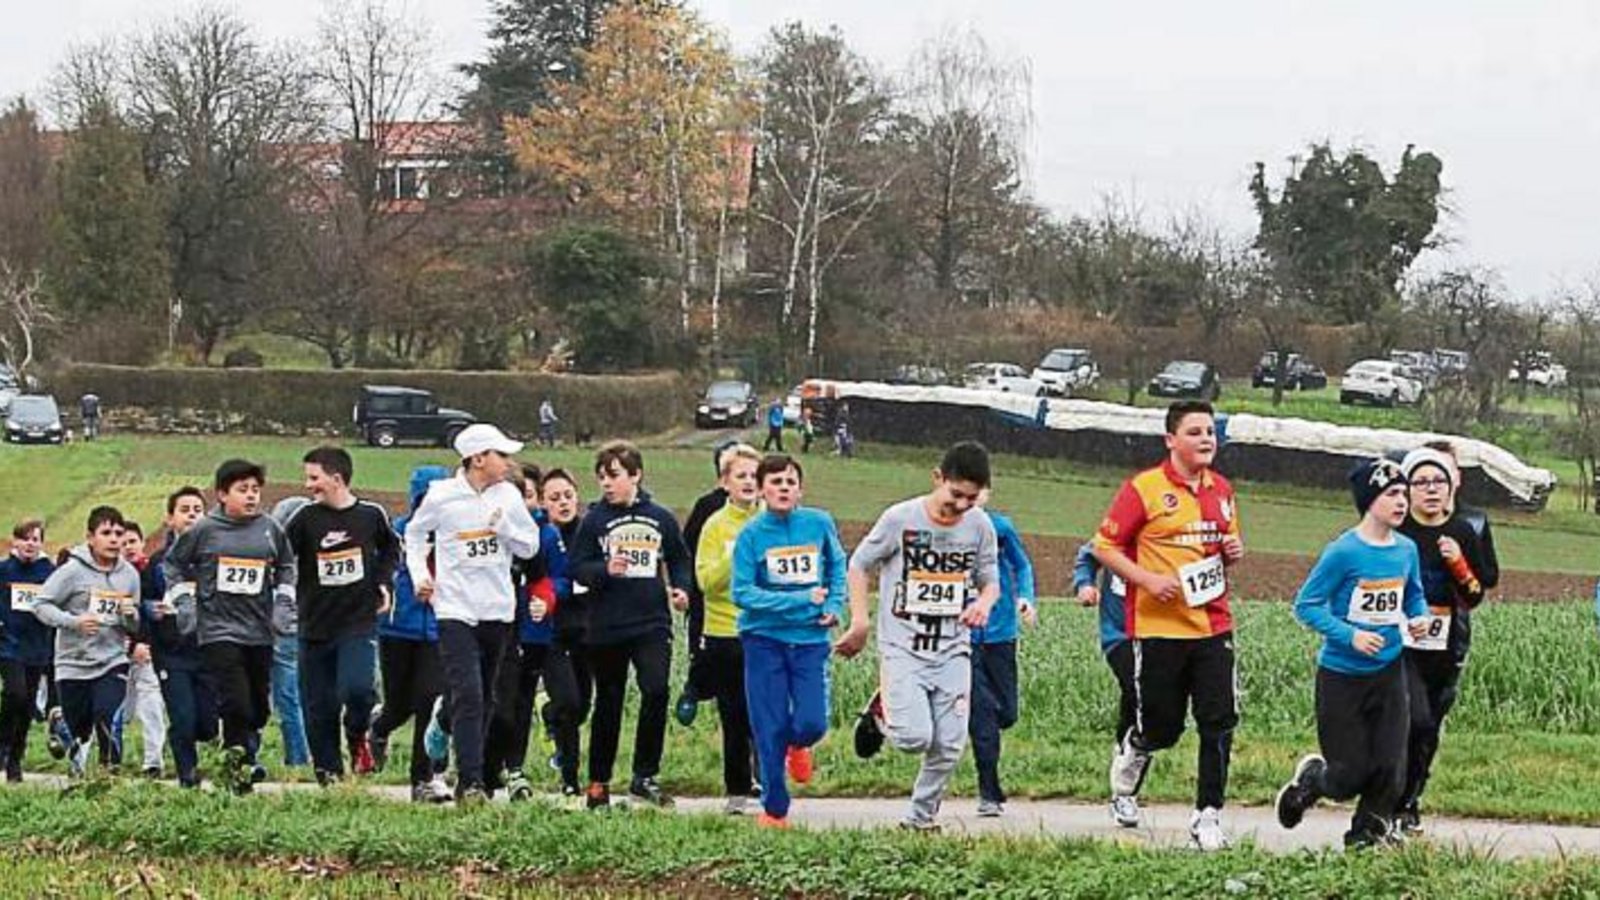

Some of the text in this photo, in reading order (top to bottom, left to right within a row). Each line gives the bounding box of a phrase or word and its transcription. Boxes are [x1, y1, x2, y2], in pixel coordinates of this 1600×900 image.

[466, 537, 499, 558] 335
[324, 558, 356, 576] 278
[777, 555, 811, 574] 313
[226, 567, 258, 584] 279
[918, 583, 955, 602] 294
[1360, 590, 1398, 612] 269
